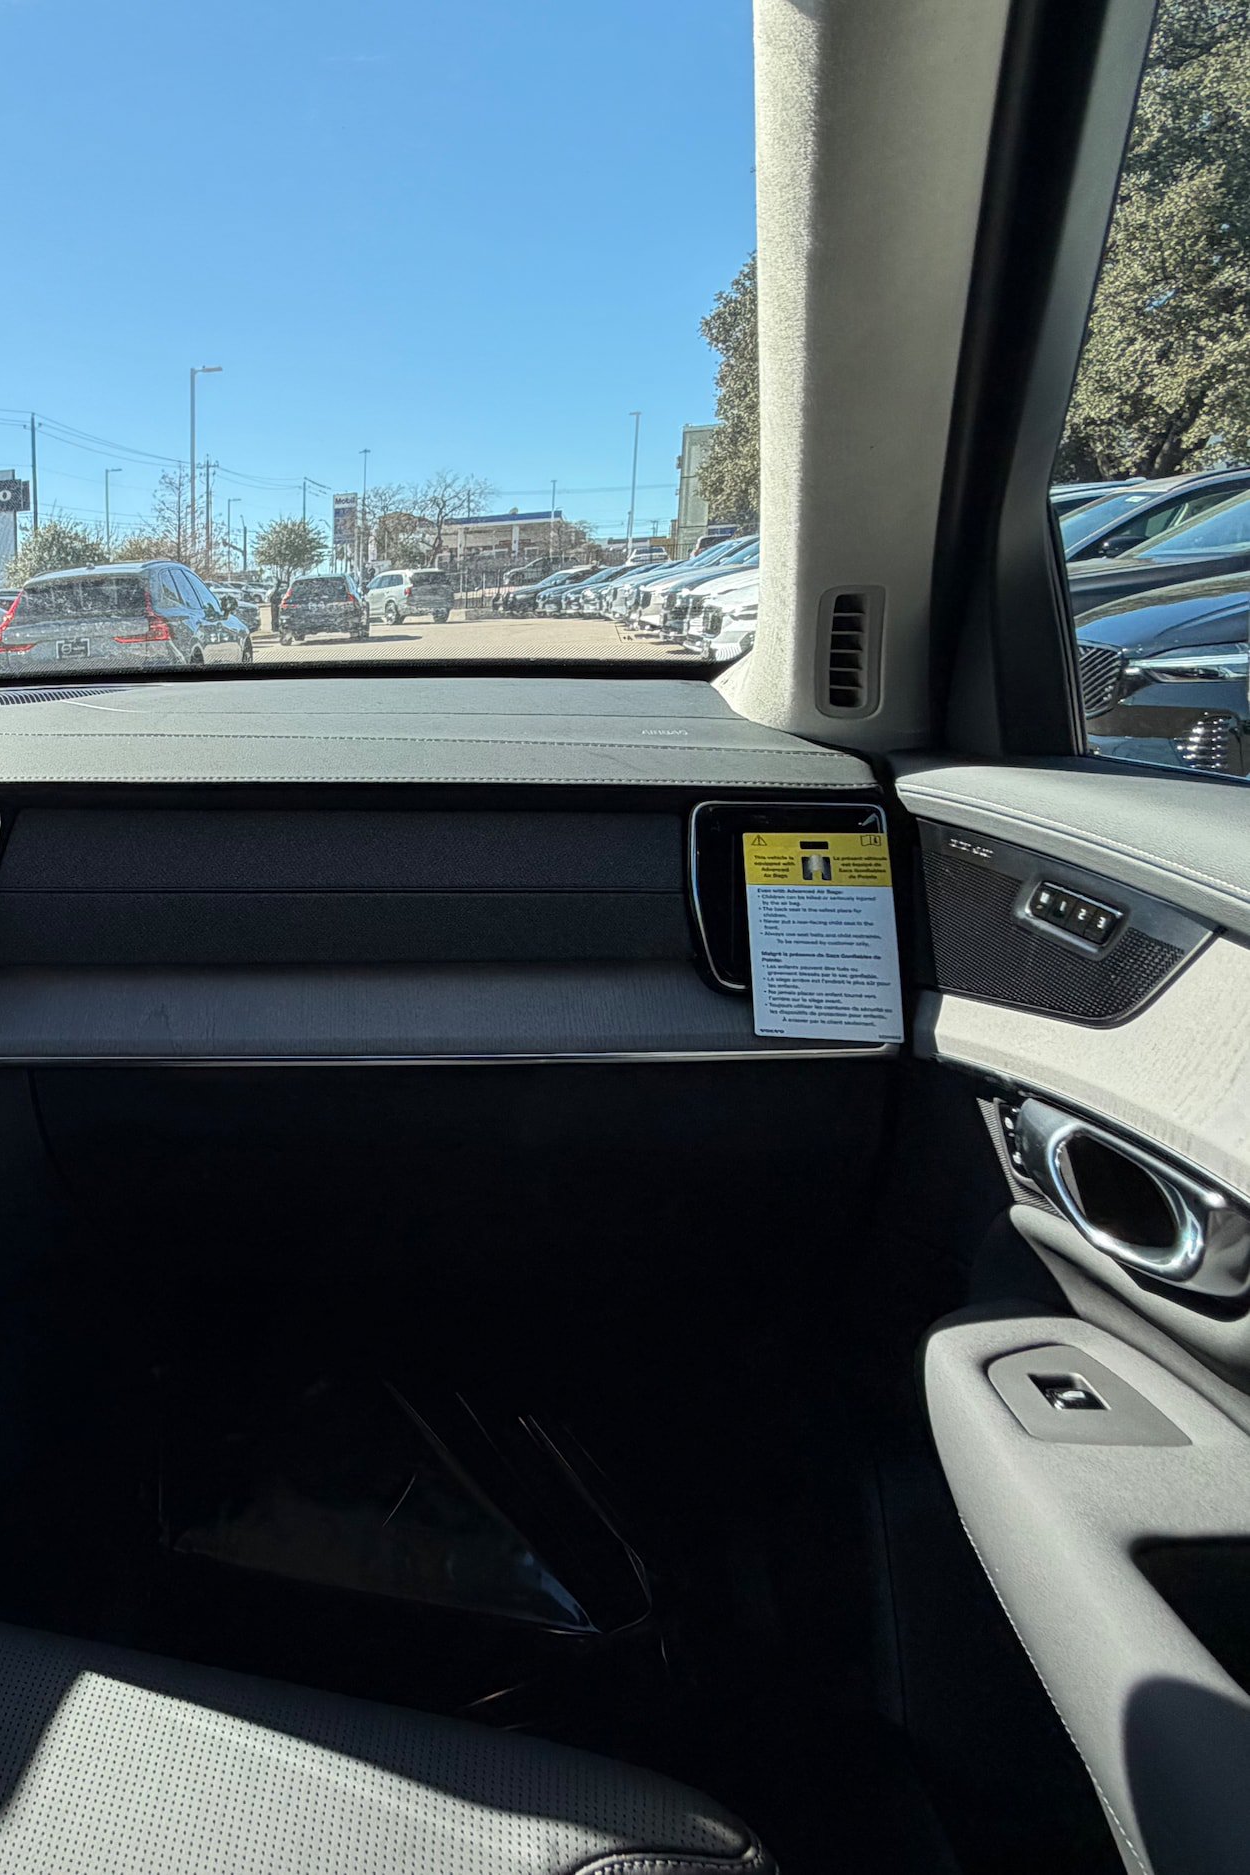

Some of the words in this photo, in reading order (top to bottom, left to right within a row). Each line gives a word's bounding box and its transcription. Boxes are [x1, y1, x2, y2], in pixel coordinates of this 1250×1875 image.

[335, 497, 355, 505] Mobil
[1078, 908, 1087, 920] 2
[1097, 916, 1107, 929] 3
